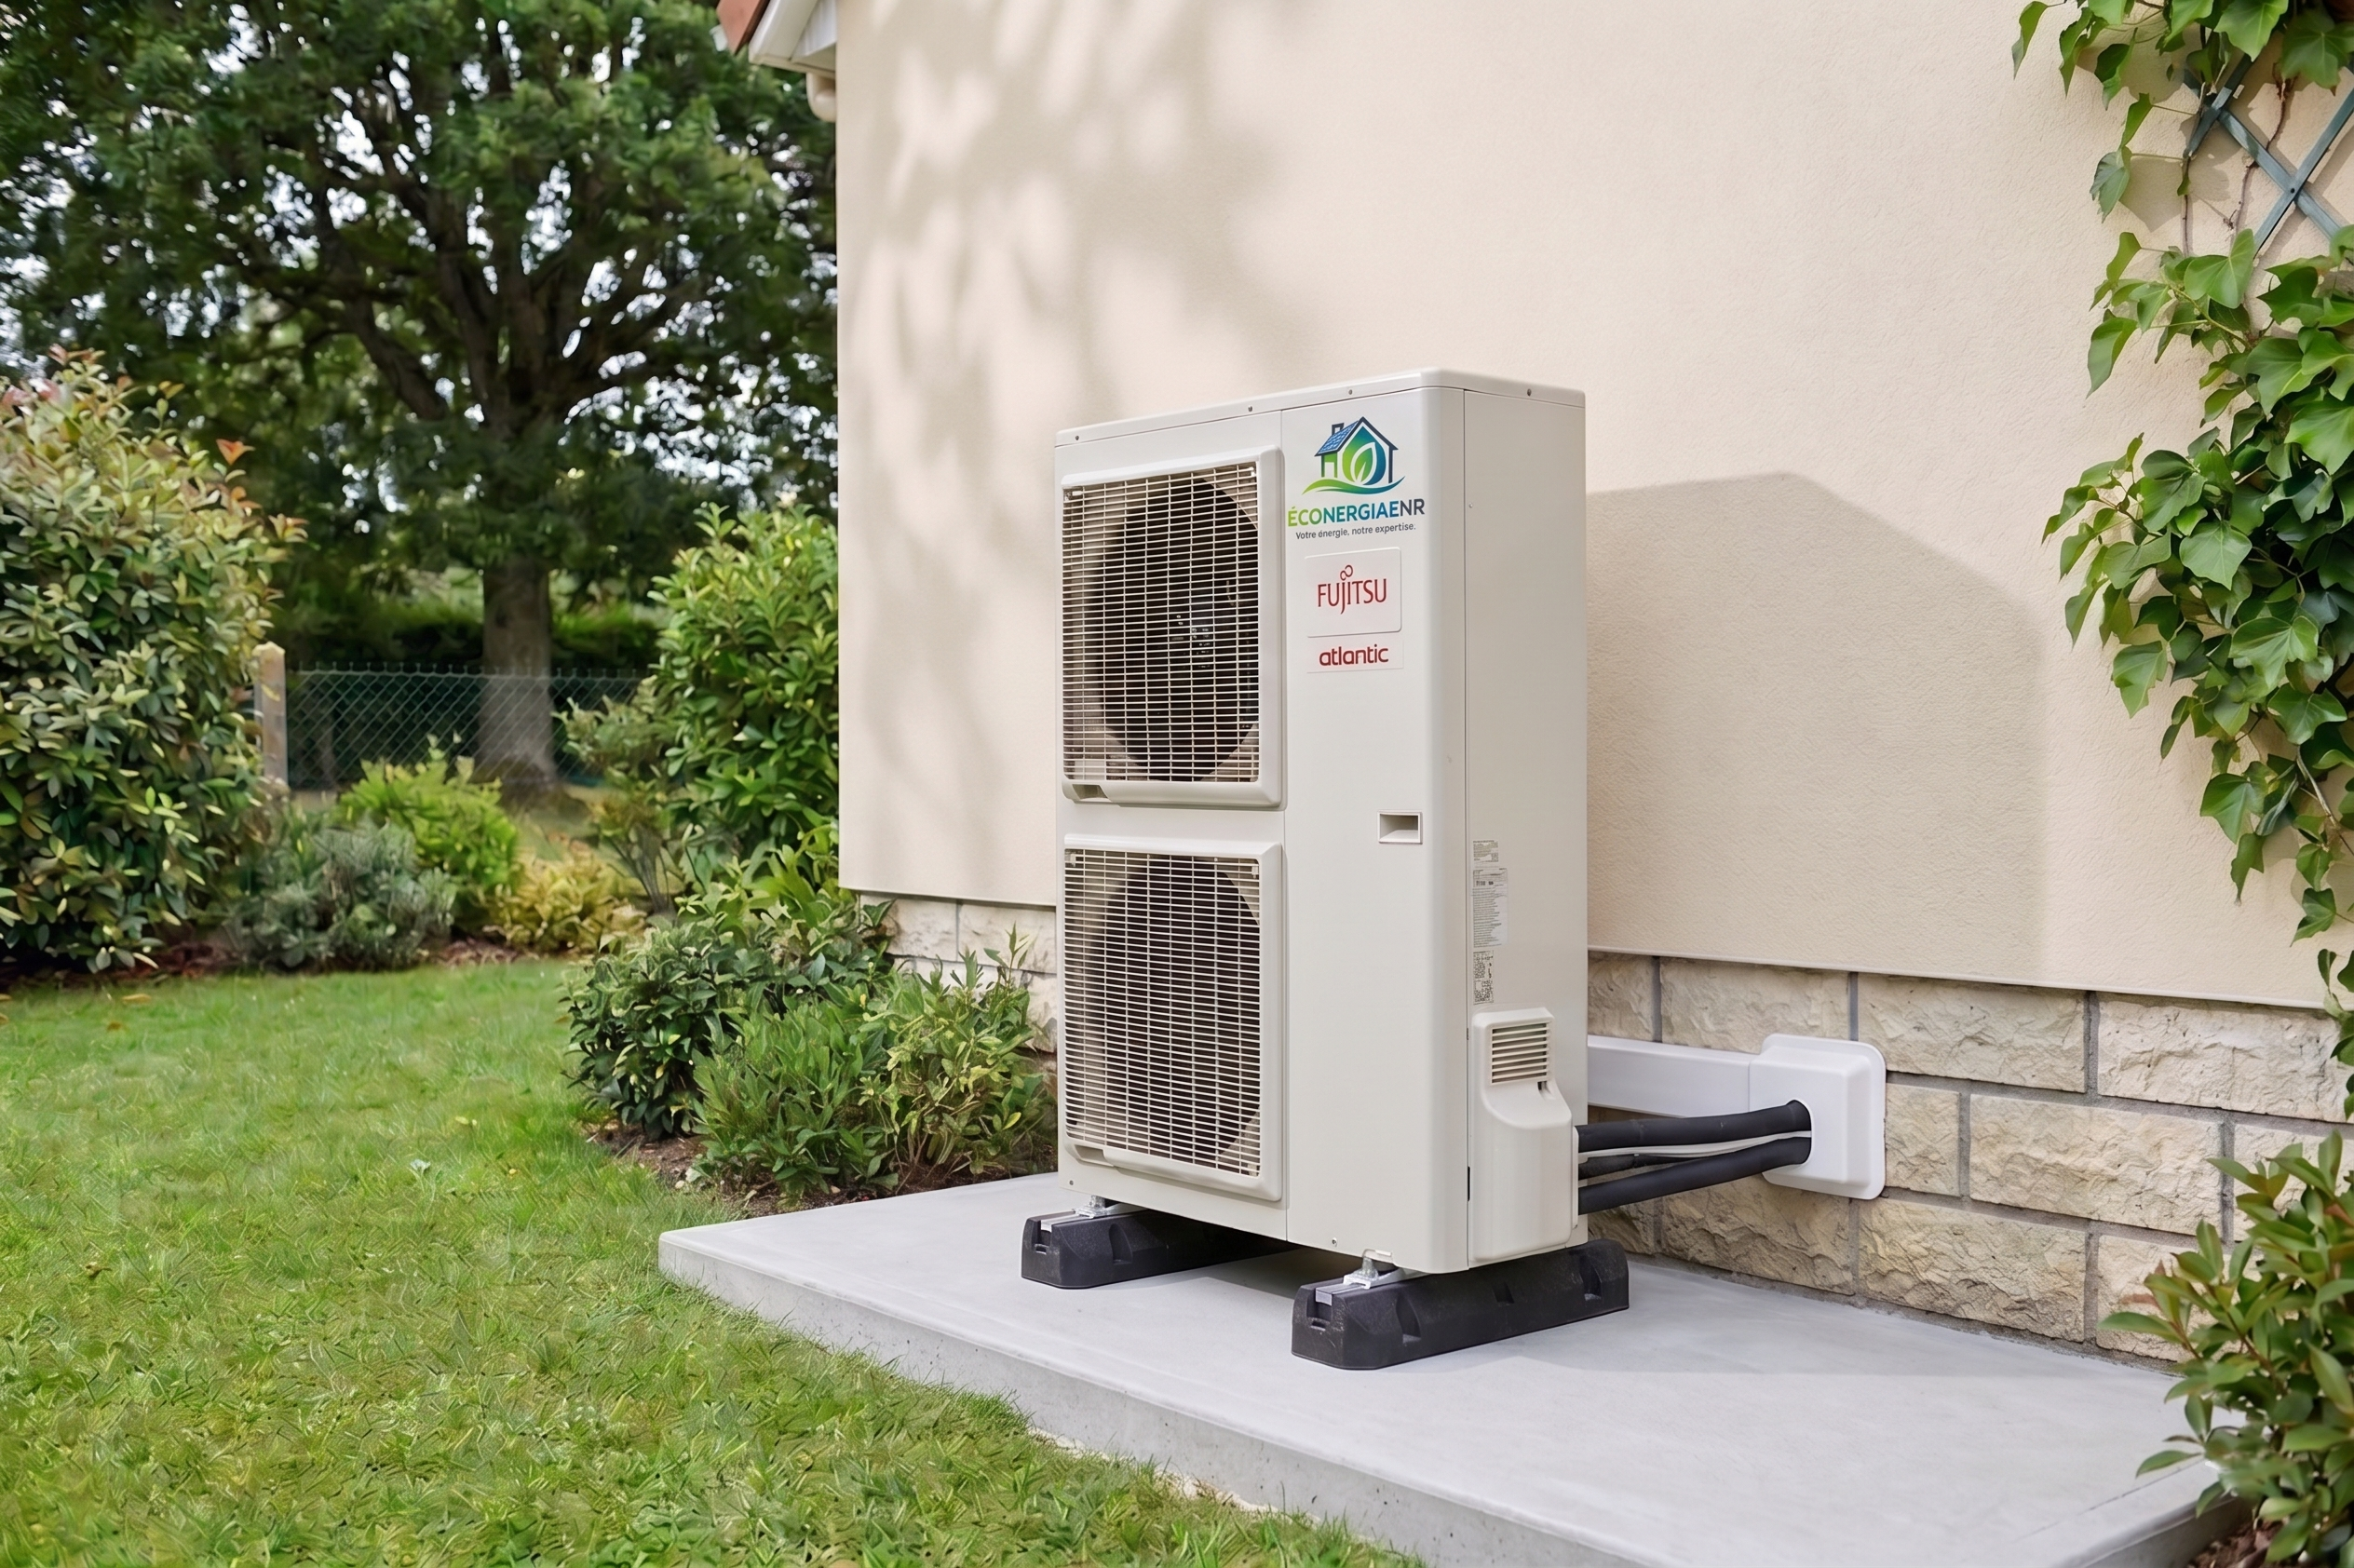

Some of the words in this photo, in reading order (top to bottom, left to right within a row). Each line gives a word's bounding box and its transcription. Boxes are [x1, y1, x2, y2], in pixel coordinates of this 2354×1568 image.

[1288, 498, 1425, 527] ÉCONERGIAENR
[1295, 532, 1316, 540] Votre
[1351, 526, 1373, 535] notre
[1318, 577, 1387, 615] FUJITSU
[1319, 643, 1388, 666] atlantic
